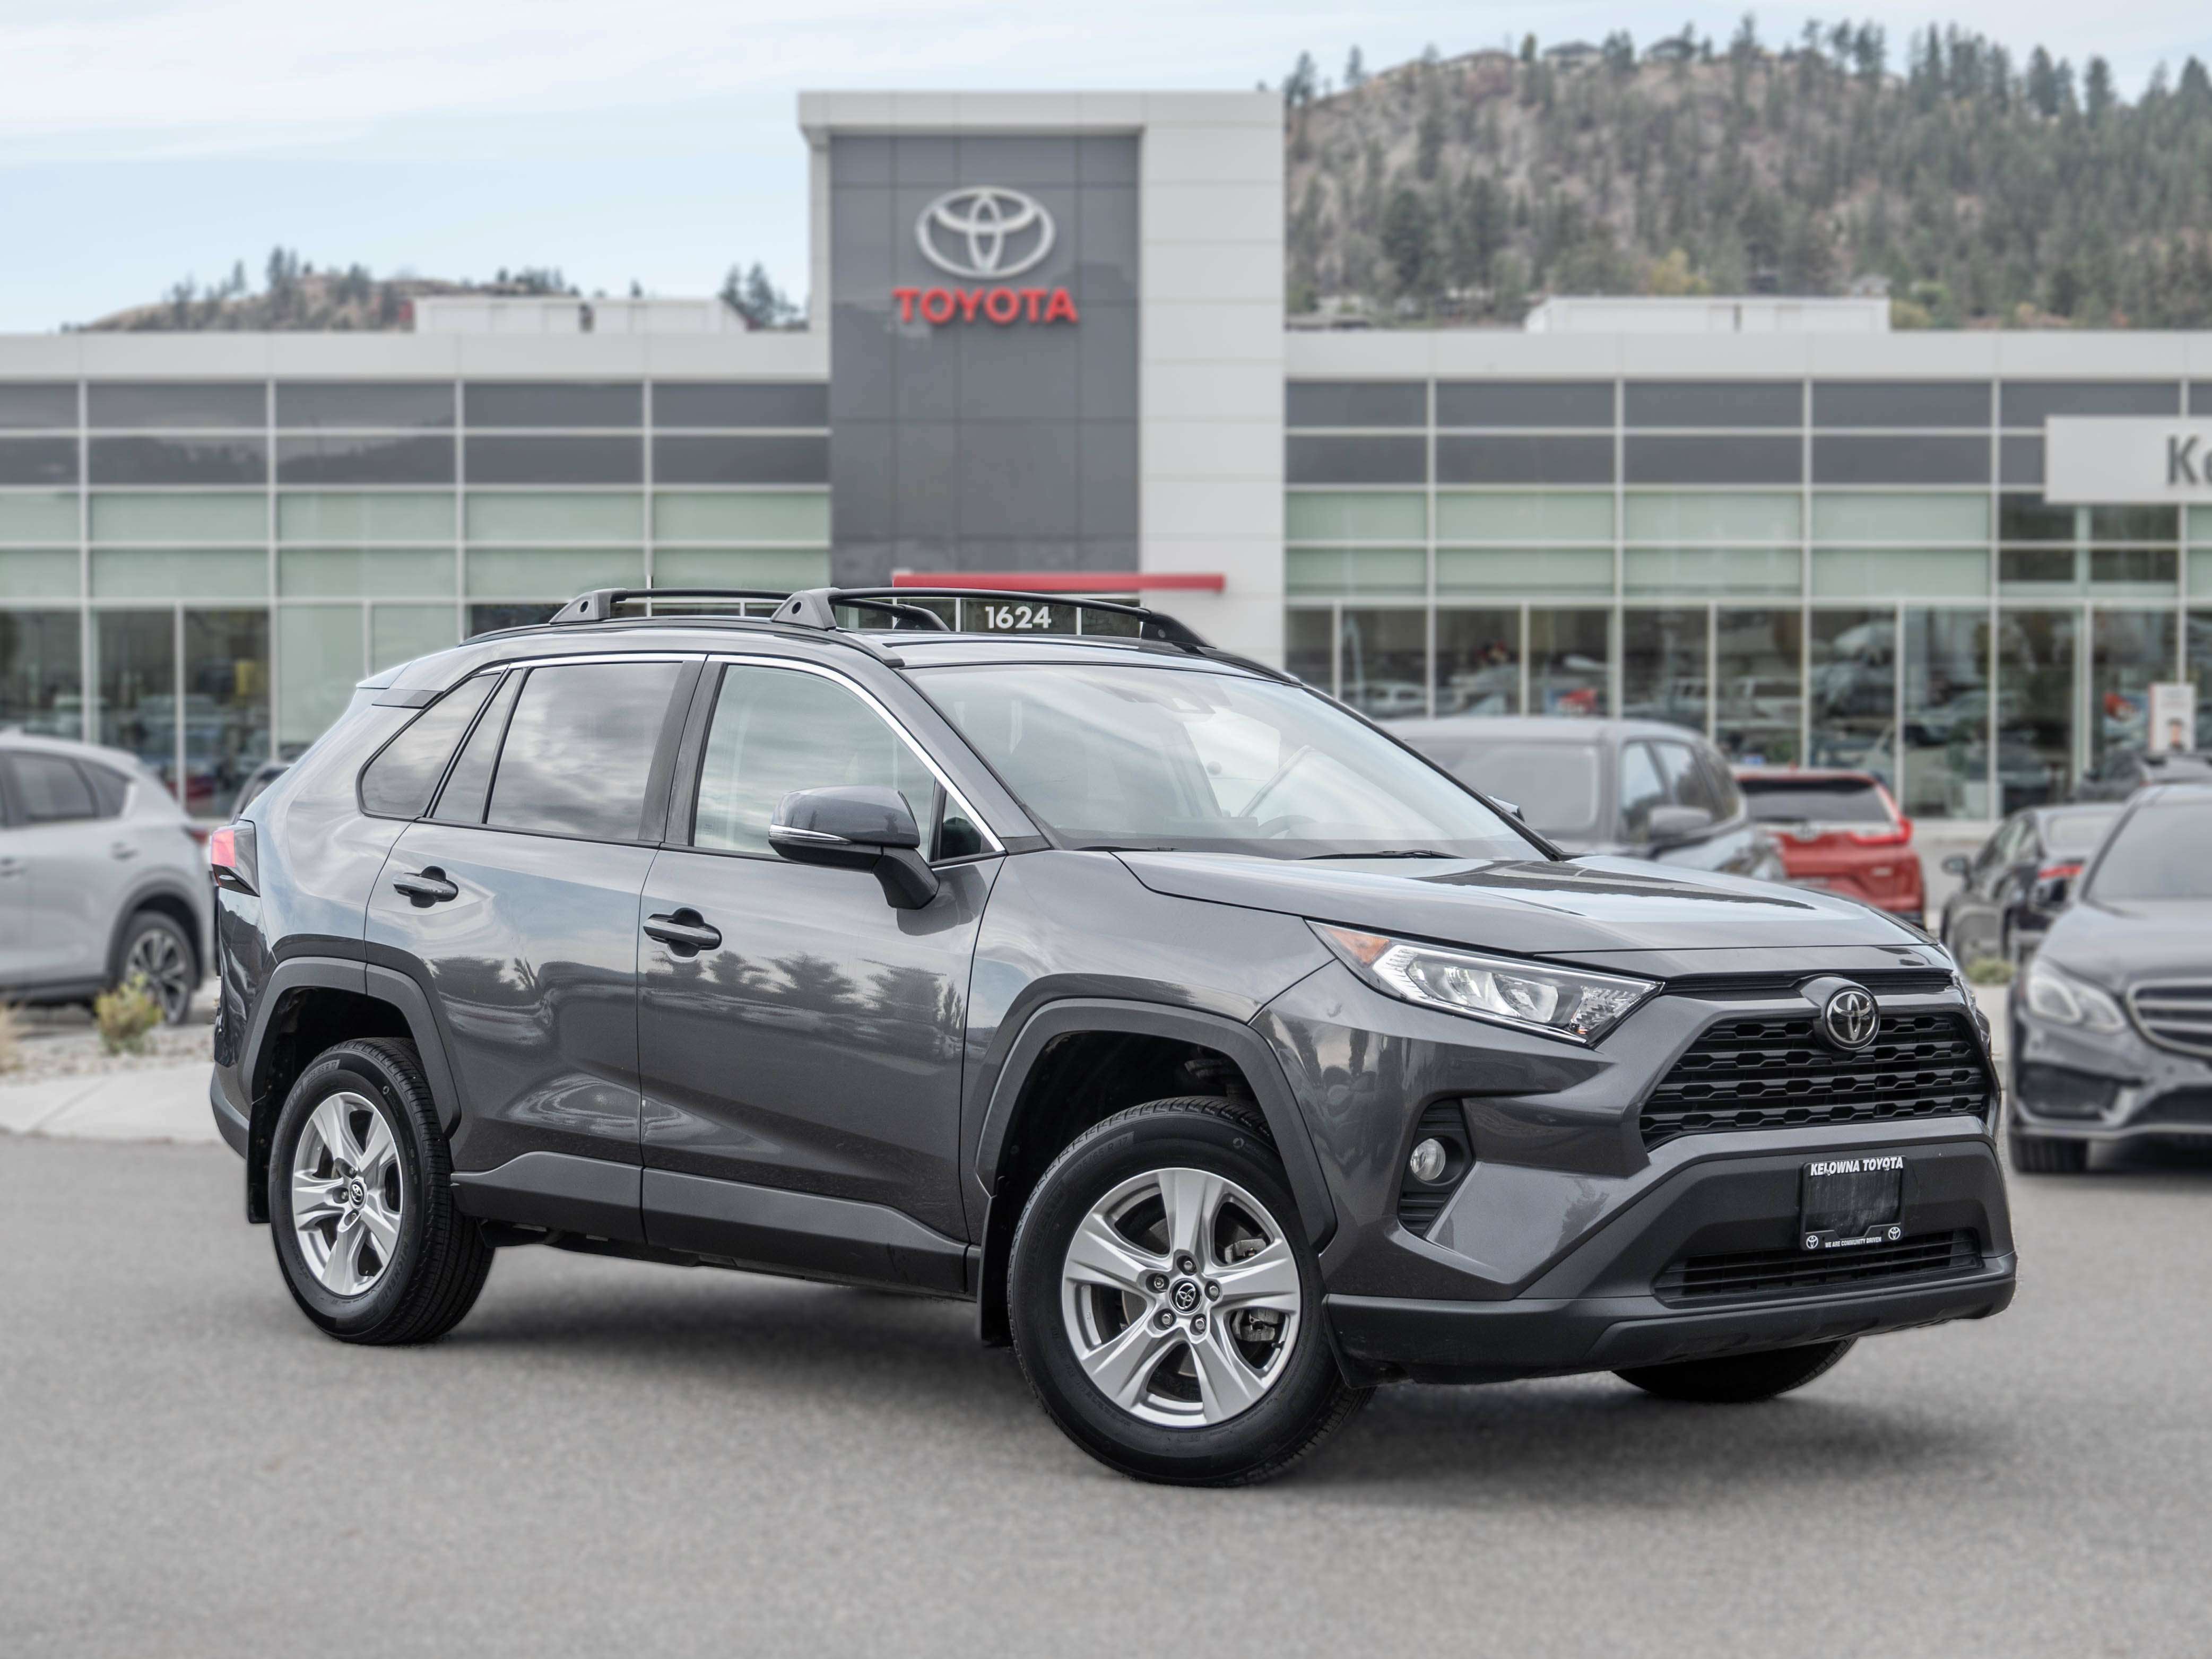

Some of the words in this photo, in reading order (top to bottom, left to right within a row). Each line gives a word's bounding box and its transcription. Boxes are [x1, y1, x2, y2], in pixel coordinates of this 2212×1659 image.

[892, 288, 1078, 323] TOYOTA
[985, 606, 1052, 629] 1624
[1810, 1160, 1860, 1176] KELOWNA
[1863, 1157, 1903, 1171] TOYOTA
